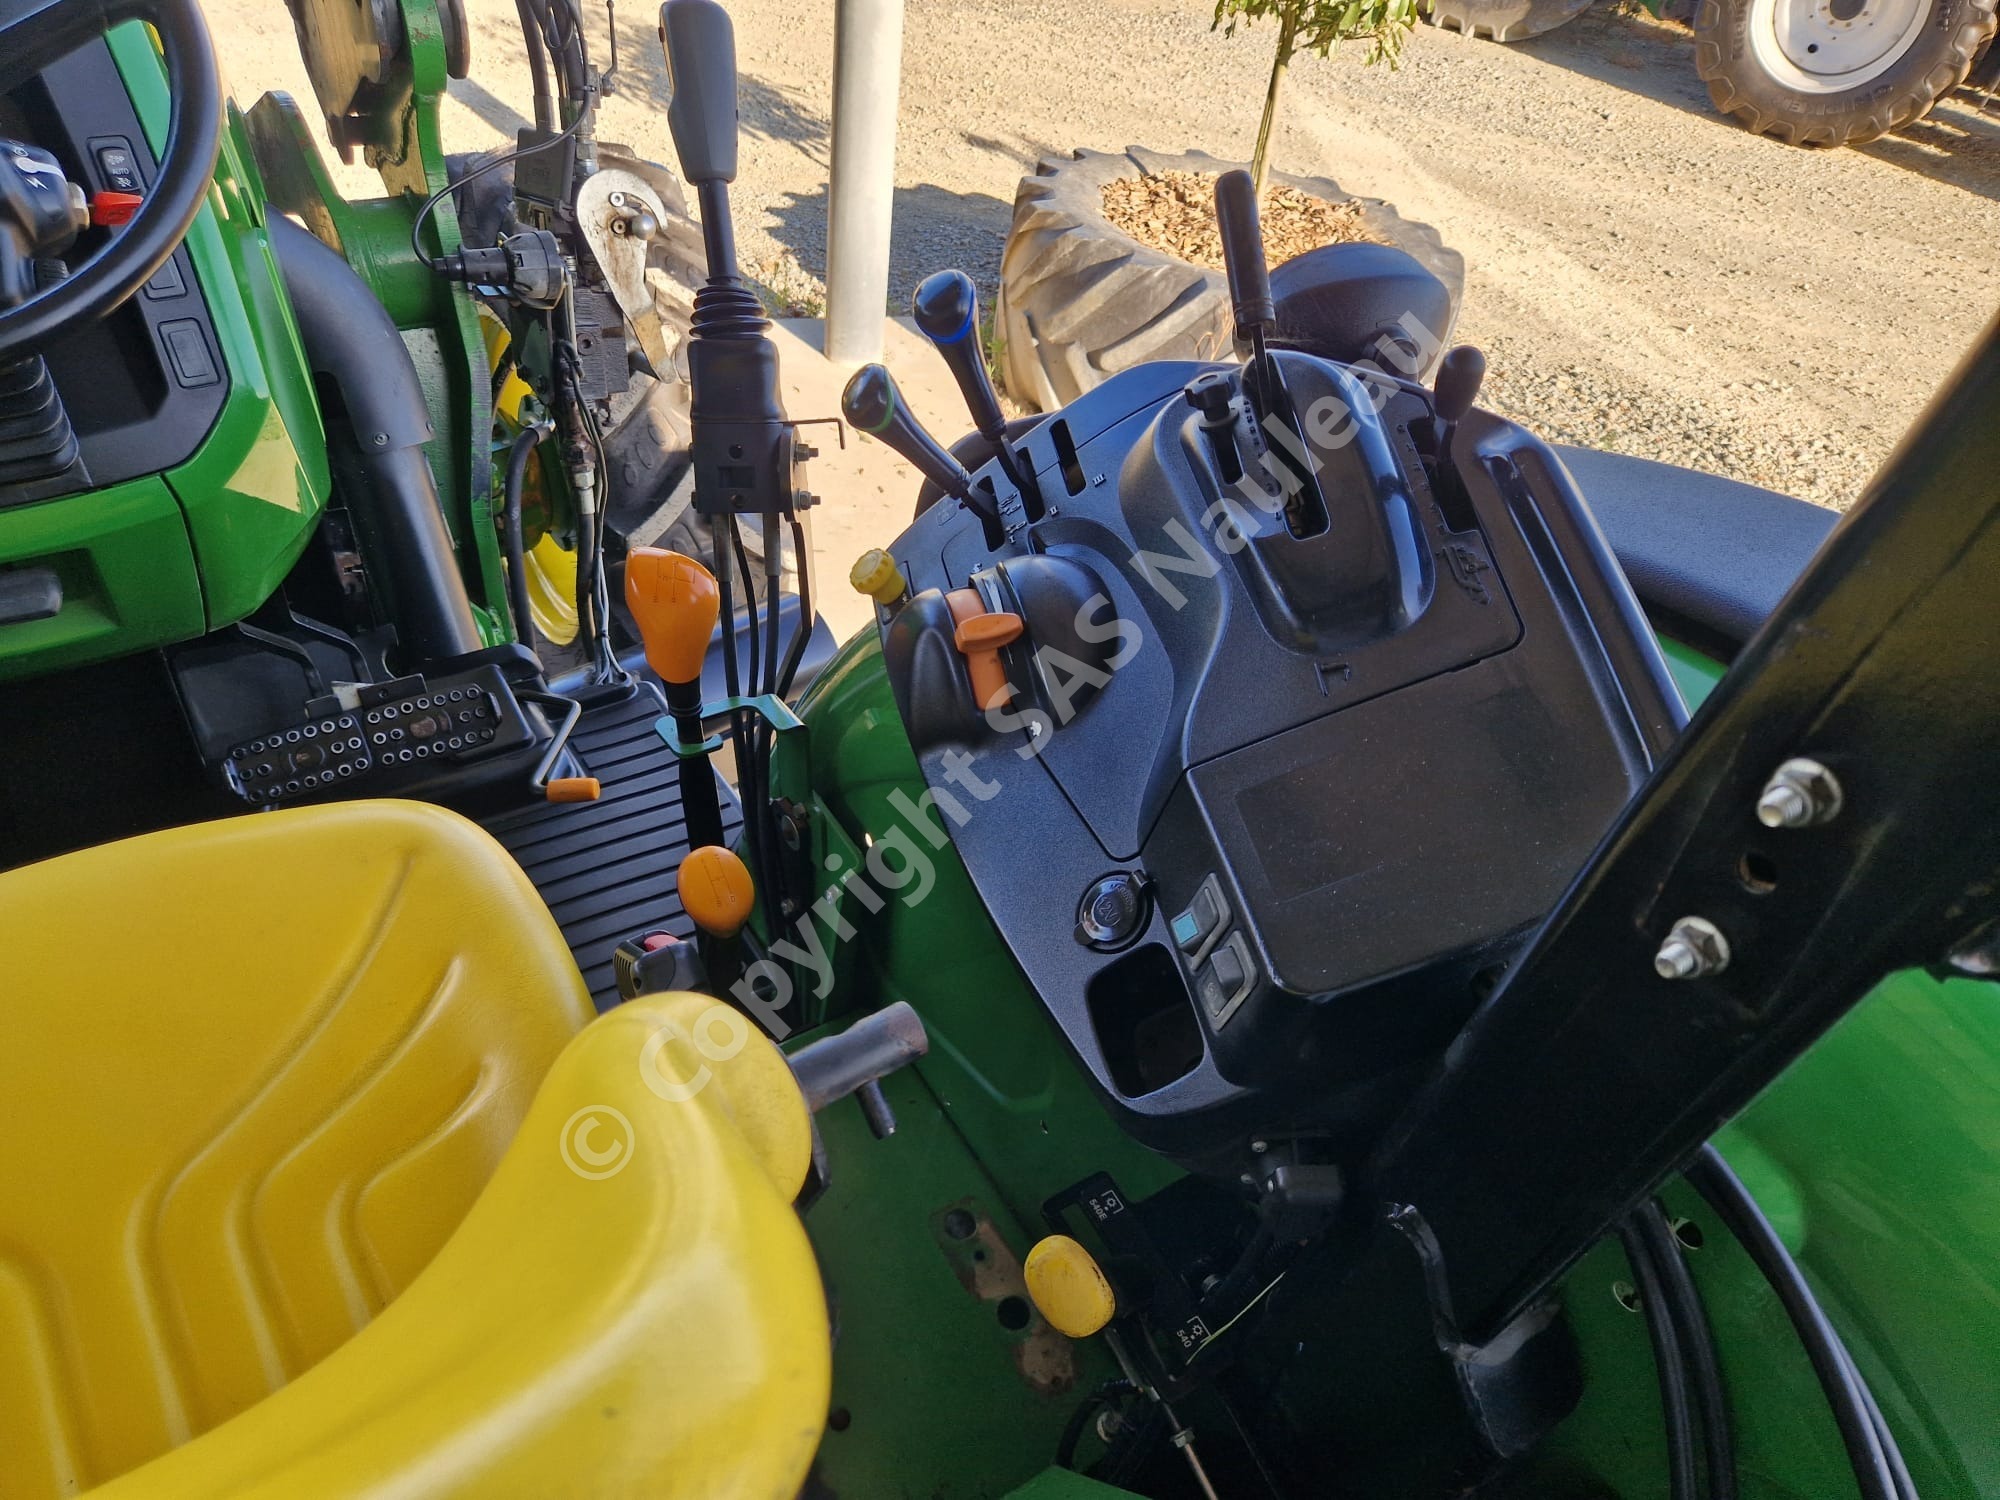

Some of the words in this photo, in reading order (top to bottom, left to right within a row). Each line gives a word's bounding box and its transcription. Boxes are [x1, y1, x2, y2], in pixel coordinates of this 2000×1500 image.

[112, 167, 129, 175] AUTO
[1088, 1198, 1108, 1221] 540E
[1176, 1329, 1193, 1349] 540
